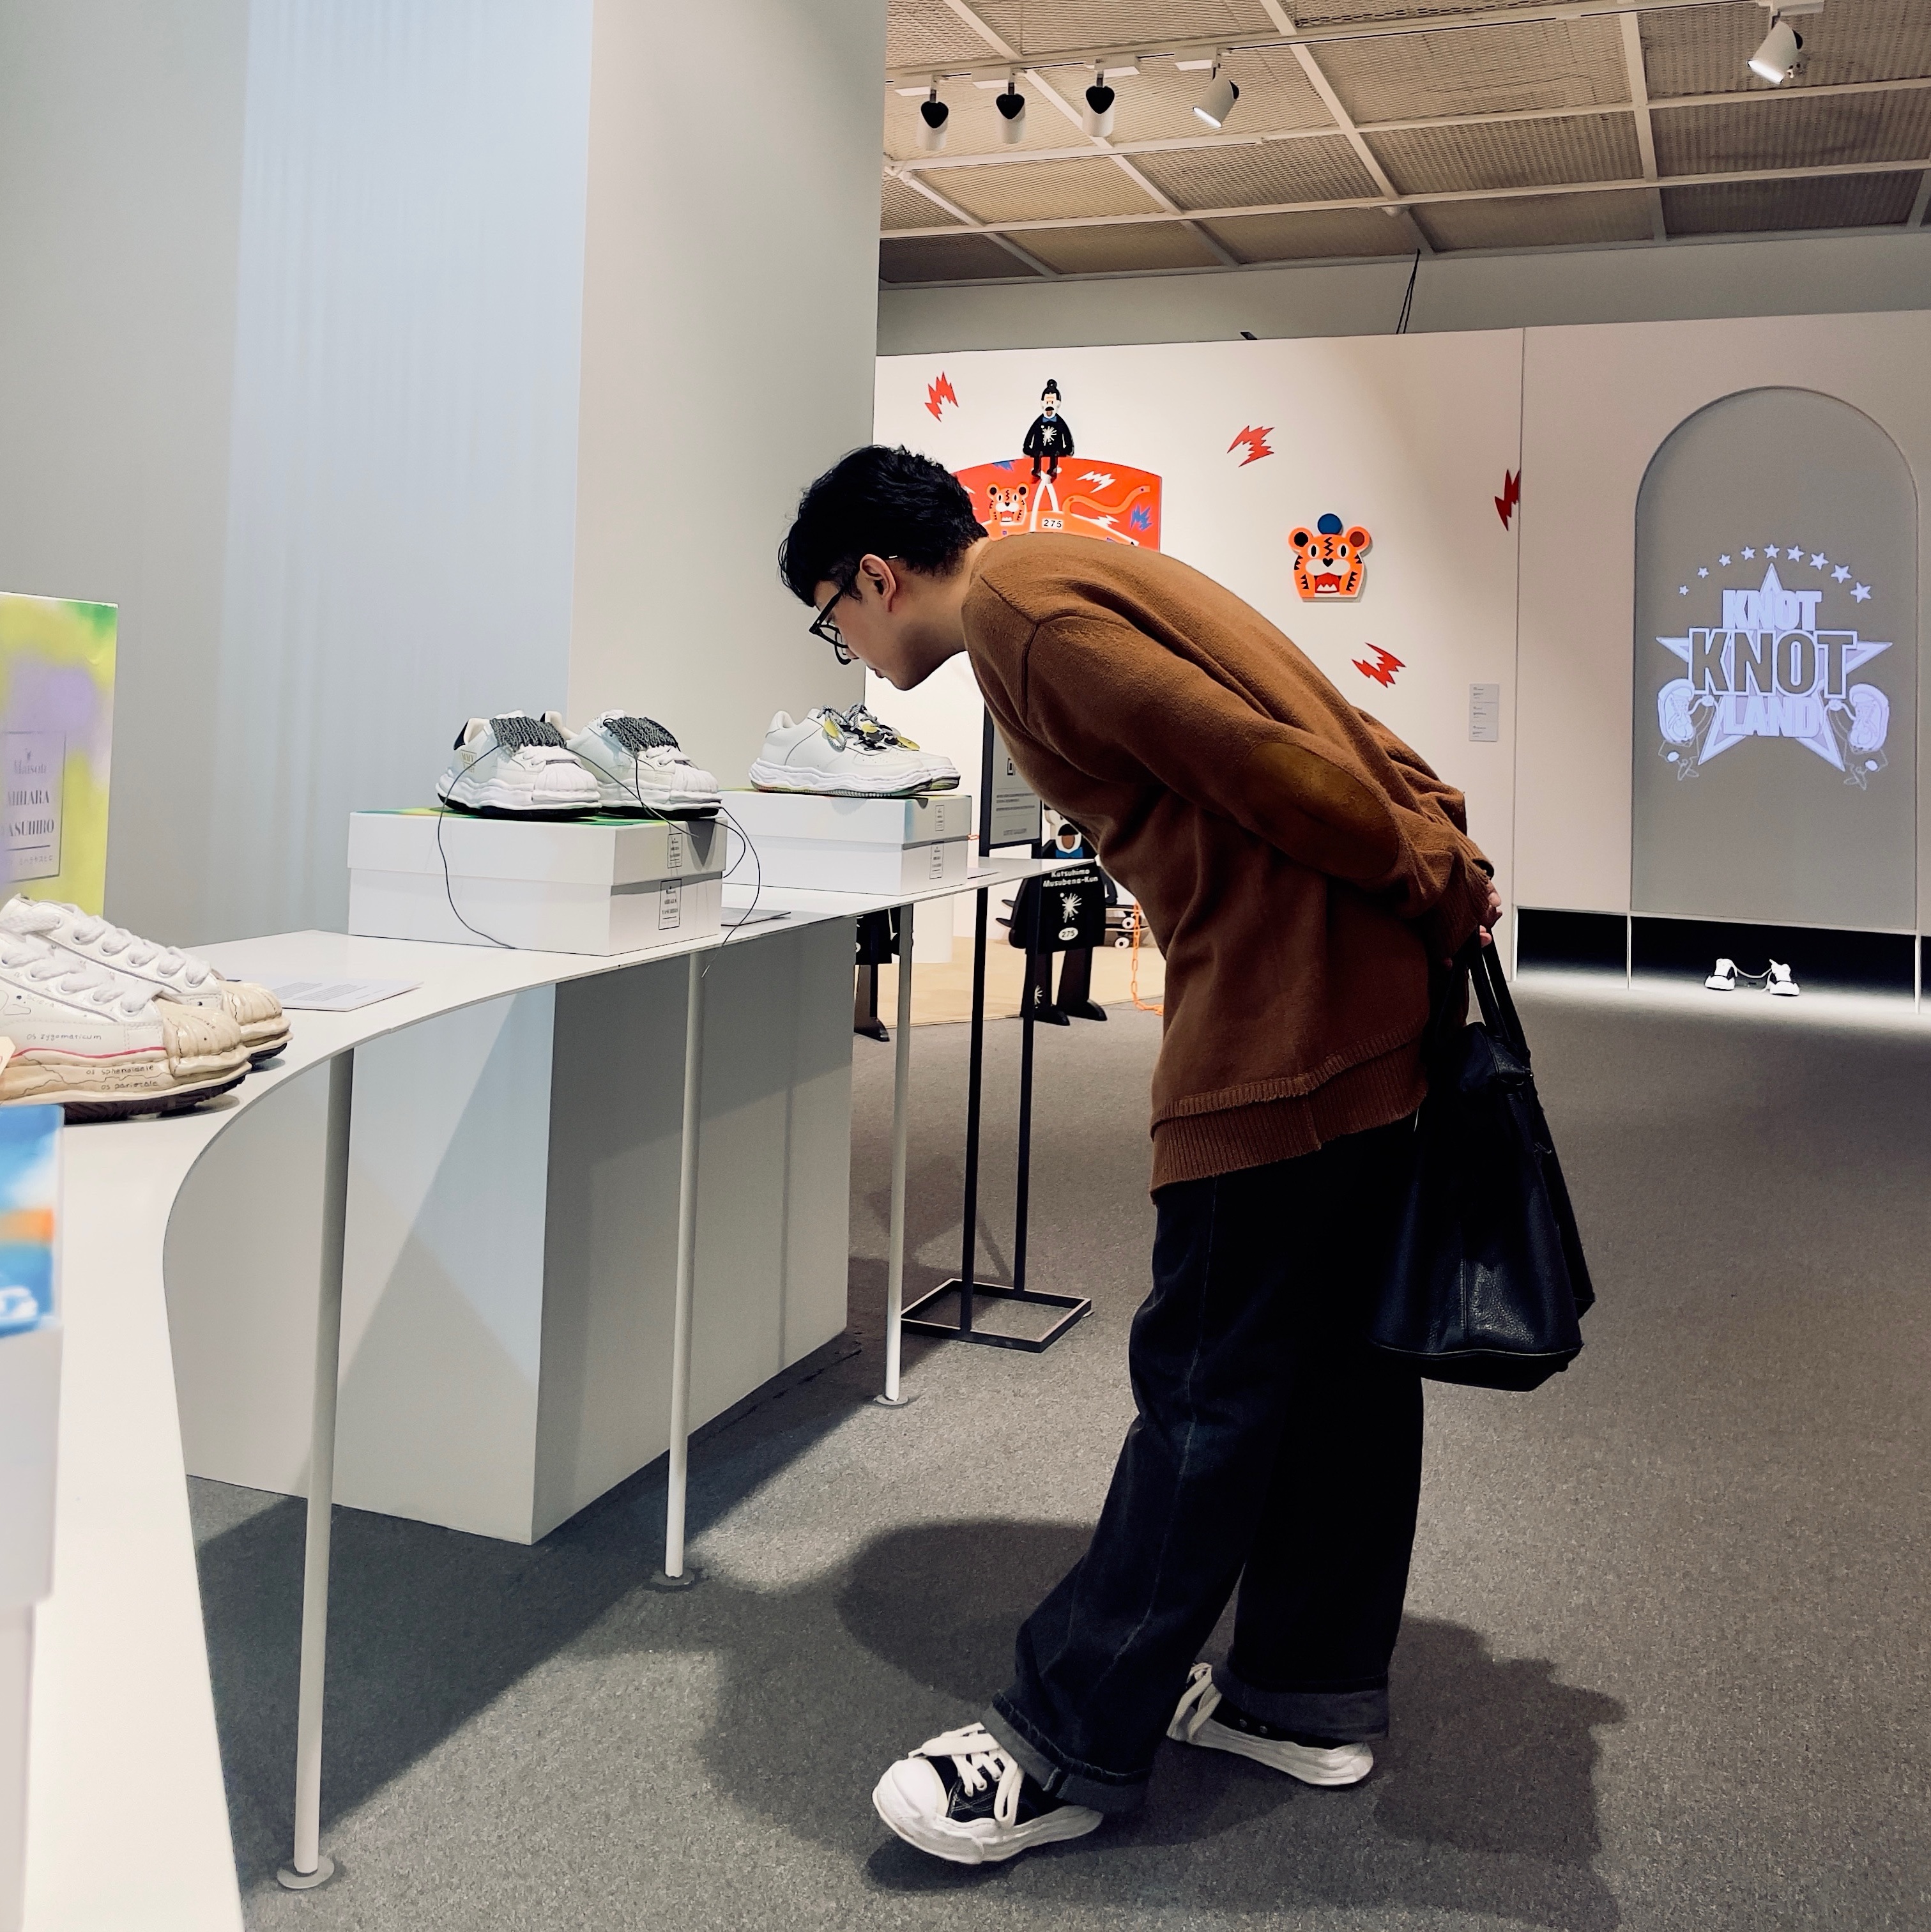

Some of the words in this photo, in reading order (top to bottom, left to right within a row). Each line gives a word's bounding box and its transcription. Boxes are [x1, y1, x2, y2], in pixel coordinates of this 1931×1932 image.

[1044, 519, 1062, 528] 275
[1722, 589, 1822, 631] KNOT
[1688, 627, 1858, 700] KNOT
[1723, 696, 1821, 738] LAND
[5, 818, 55, 837] ASUHIRO
